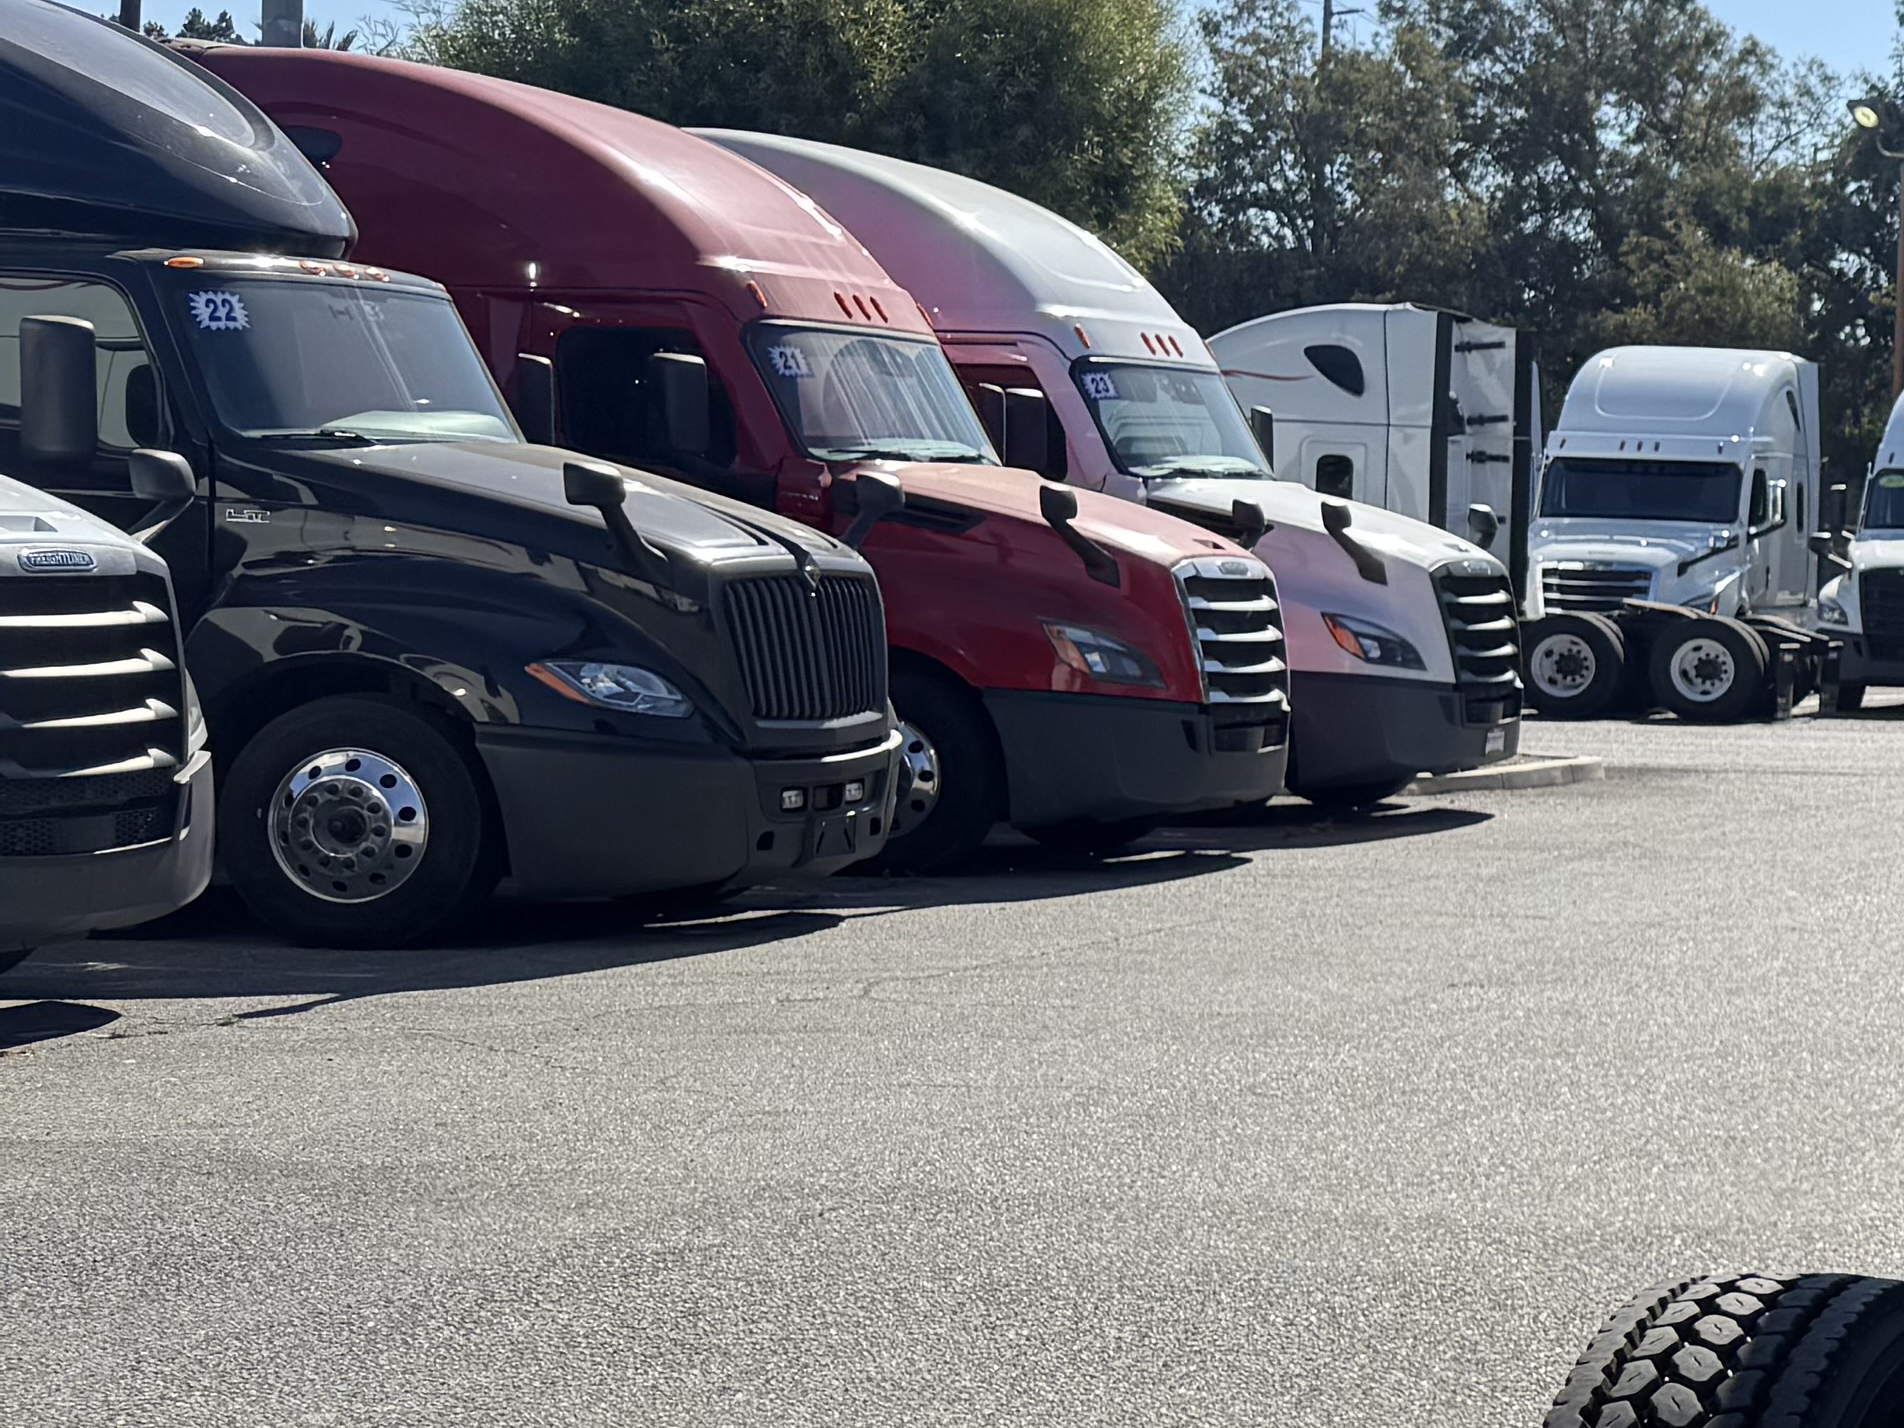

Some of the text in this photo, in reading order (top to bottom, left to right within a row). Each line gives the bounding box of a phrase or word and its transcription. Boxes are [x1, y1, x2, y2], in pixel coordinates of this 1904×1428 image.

[204, 298, 239, 323] 22
[778, 351, 801, 371] 21
[1090, 376, 1110, 394] 23
